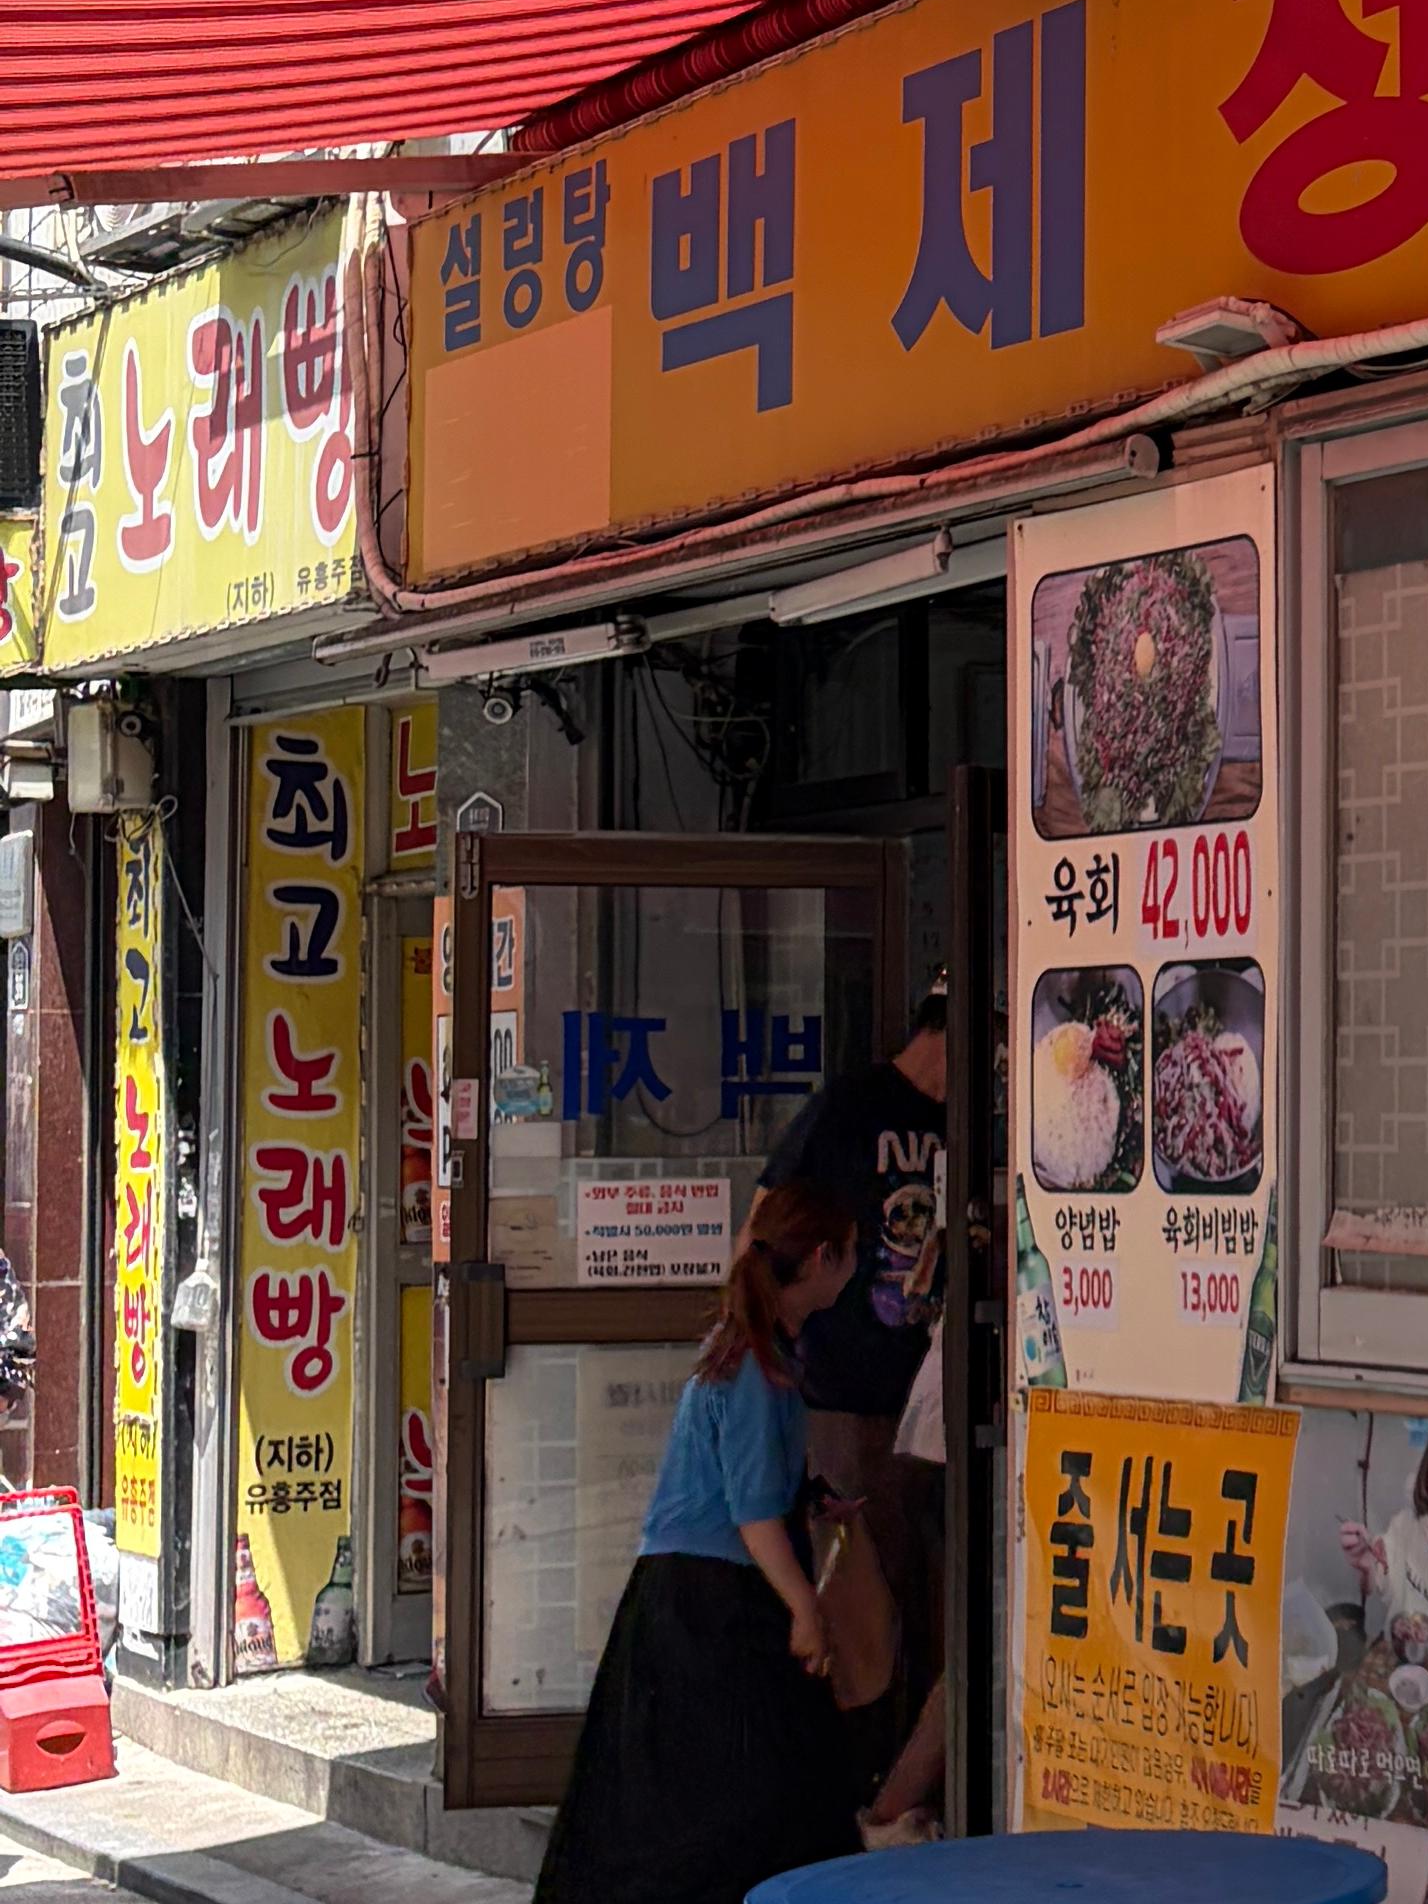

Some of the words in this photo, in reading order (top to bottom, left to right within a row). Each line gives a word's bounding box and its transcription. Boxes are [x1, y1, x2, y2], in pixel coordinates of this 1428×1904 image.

[440, 157, 612, 353] 설렁탕
[226, 570, 276, 614] (지하)
[266, 734, 348, 978] 최고
[1044, 853, 1120, 939] 육회
[1139, 829, 1254, 952] 42,000
[1055, 1204, 1121, 1252] 양념밥
[1161, 1205, 1260, 1256] 육회비빔밥
[1062, 1266, 1113, 1316] 3,000
[1180, 1271, 1240, 1322] 13,000
[254, 1432, 335, 1477] (지하)
[244, 1479, 343, 1514] 유흥주점
[1050, 1449, 1260, 1670] 줄서는곳
[1306, 1742, 1372, 1778] 따로따로
[1376, 1751, 1424, 1791] 먹으면
